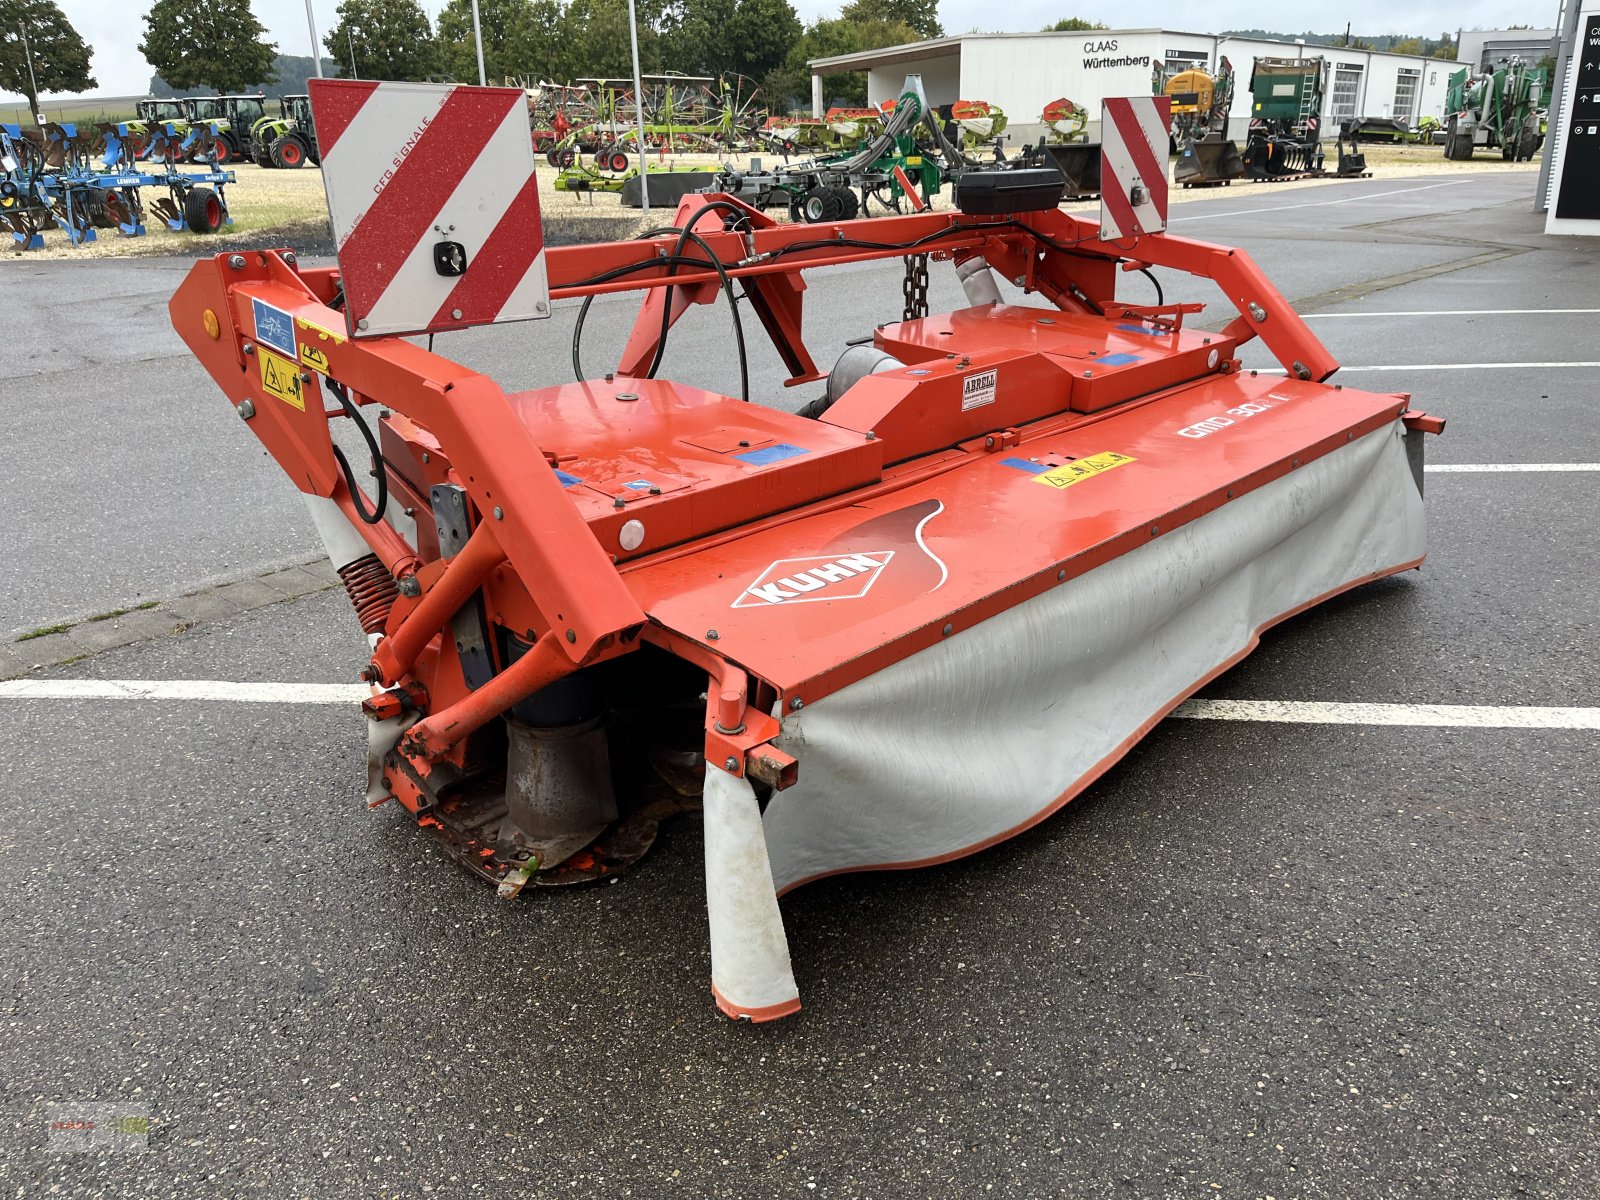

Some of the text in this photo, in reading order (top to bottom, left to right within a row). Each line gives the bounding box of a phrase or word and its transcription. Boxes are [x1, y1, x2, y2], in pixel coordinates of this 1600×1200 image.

[1084, 40, 1118, 53] CLAAS
[1083, 55, 1150, 69] Württemberg
[373, 169, 394, 195] CFG
[965, 374, 995, 395] ABRELL
[1177, 416, 1236, 438] GMD
[746, 553, 885, 604] KUHN
